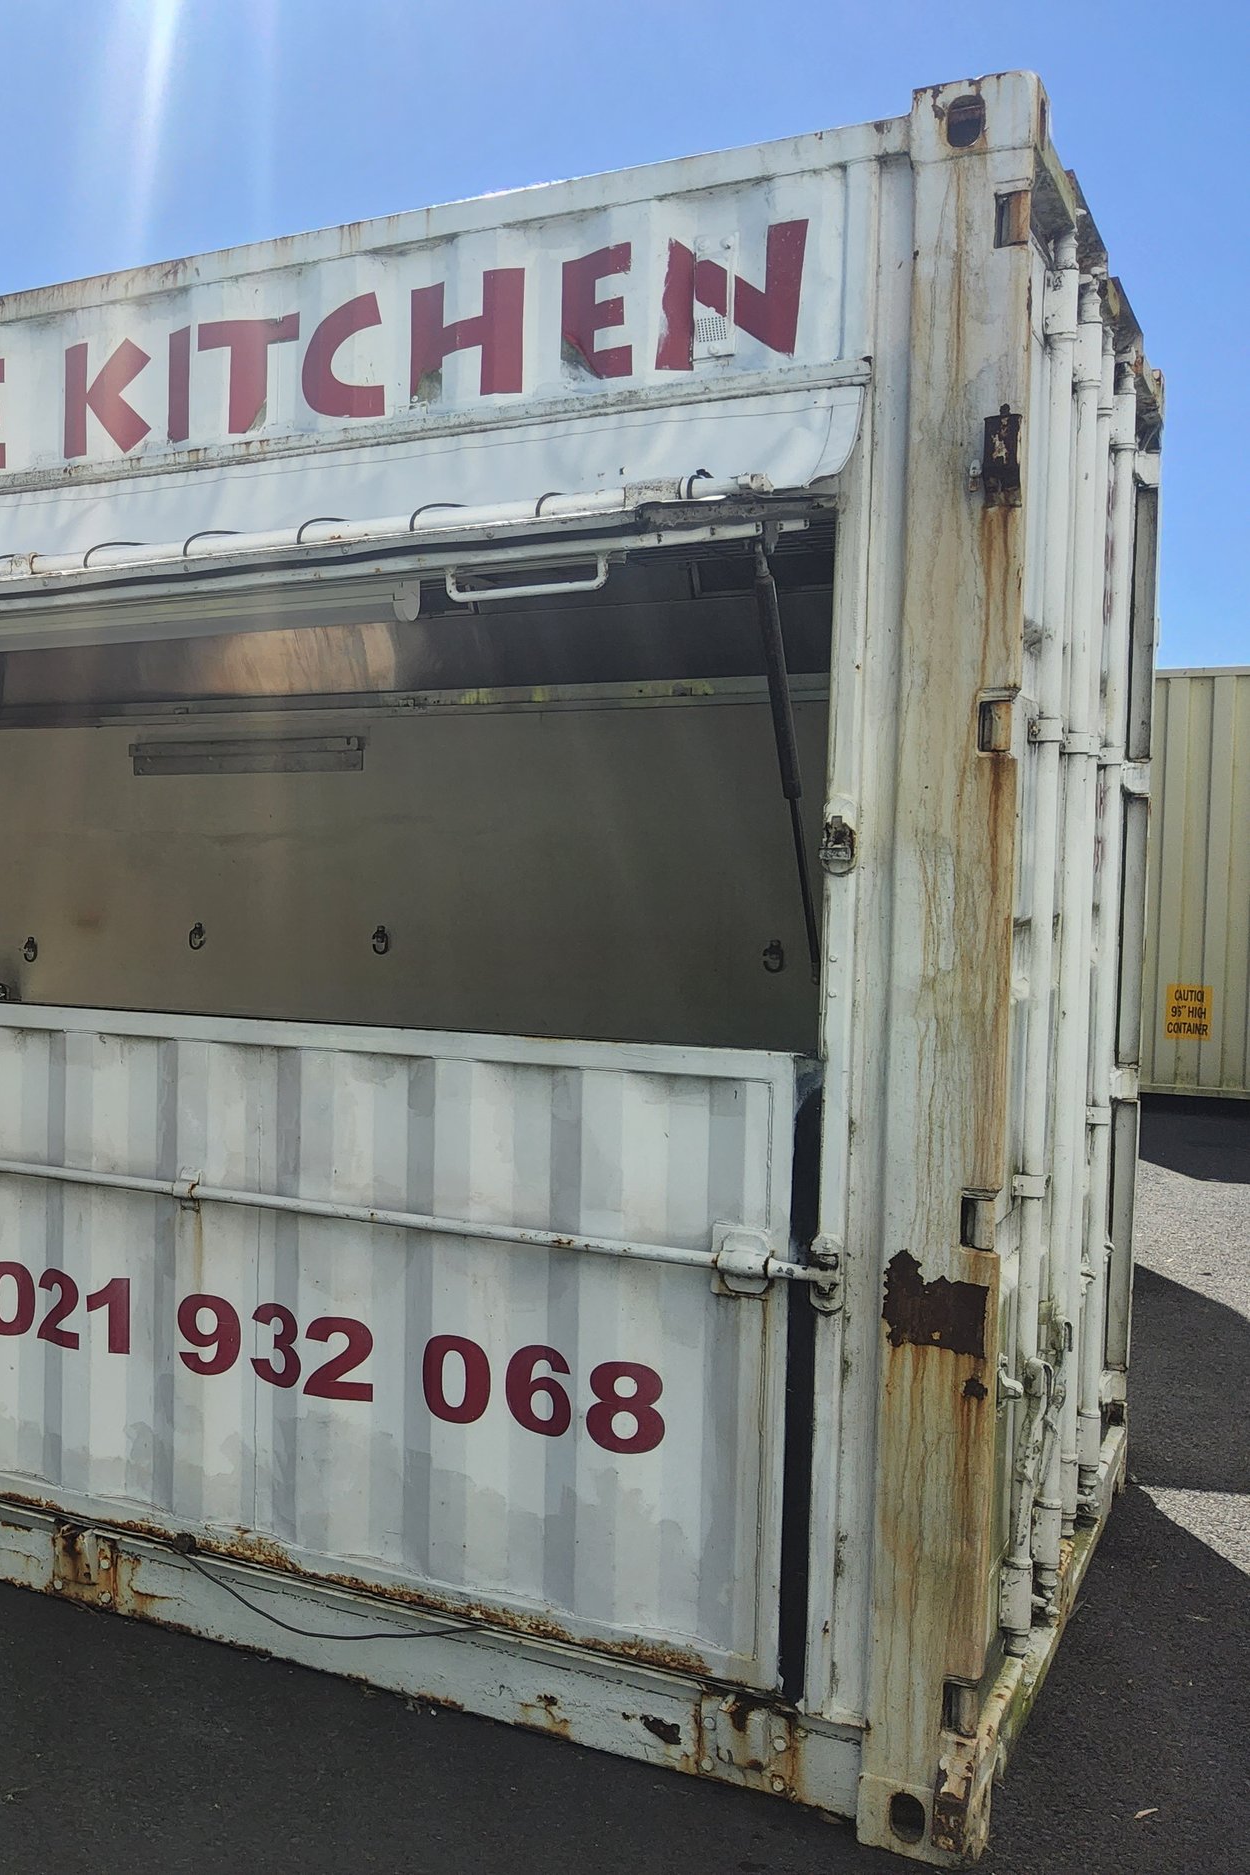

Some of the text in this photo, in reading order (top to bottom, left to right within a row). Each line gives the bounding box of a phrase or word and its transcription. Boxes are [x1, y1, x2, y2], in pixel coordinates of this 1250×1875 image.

[63, 218, 809, 459] KITCHEN
[177, 1294, 374, 1403] 932
[422, 1335, 666, 1456] 068
